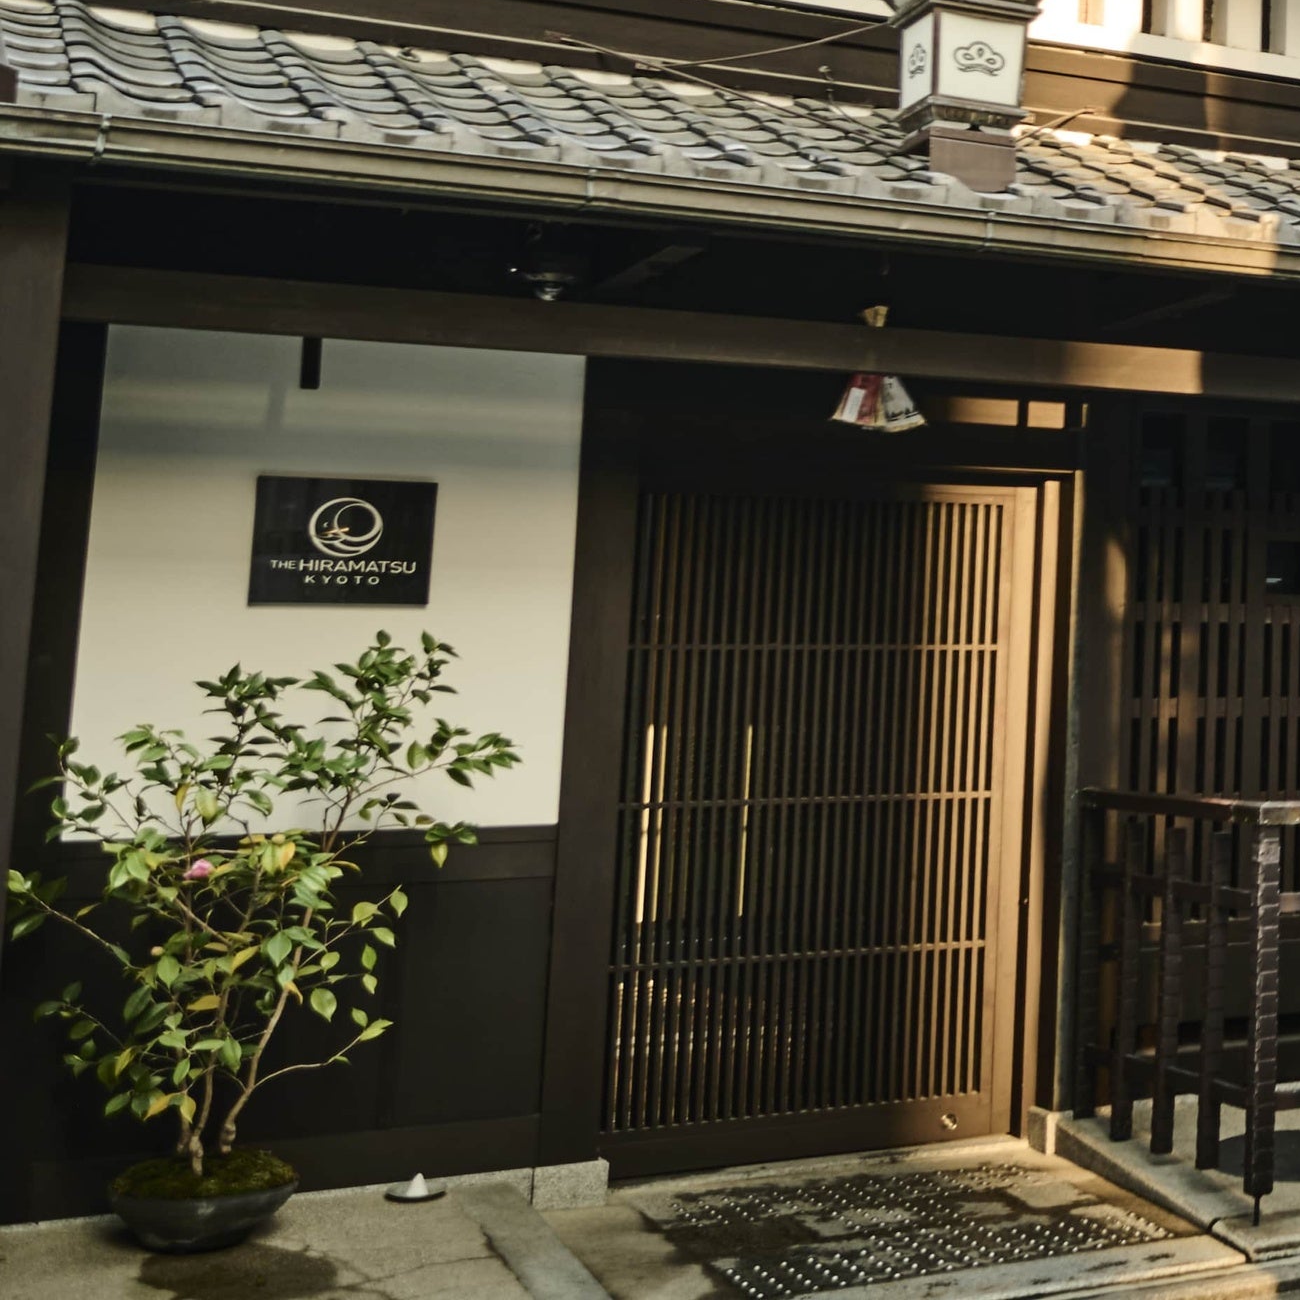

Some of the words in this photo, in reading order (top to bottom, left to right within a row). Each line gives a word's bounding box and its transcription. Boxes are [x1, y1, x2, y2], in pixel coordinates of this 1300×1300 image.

[270, 559, 296, 570] THE
[298, 559, 416, 574] HIRAMATSU
[304, 575, 380, 585] KYOTO
